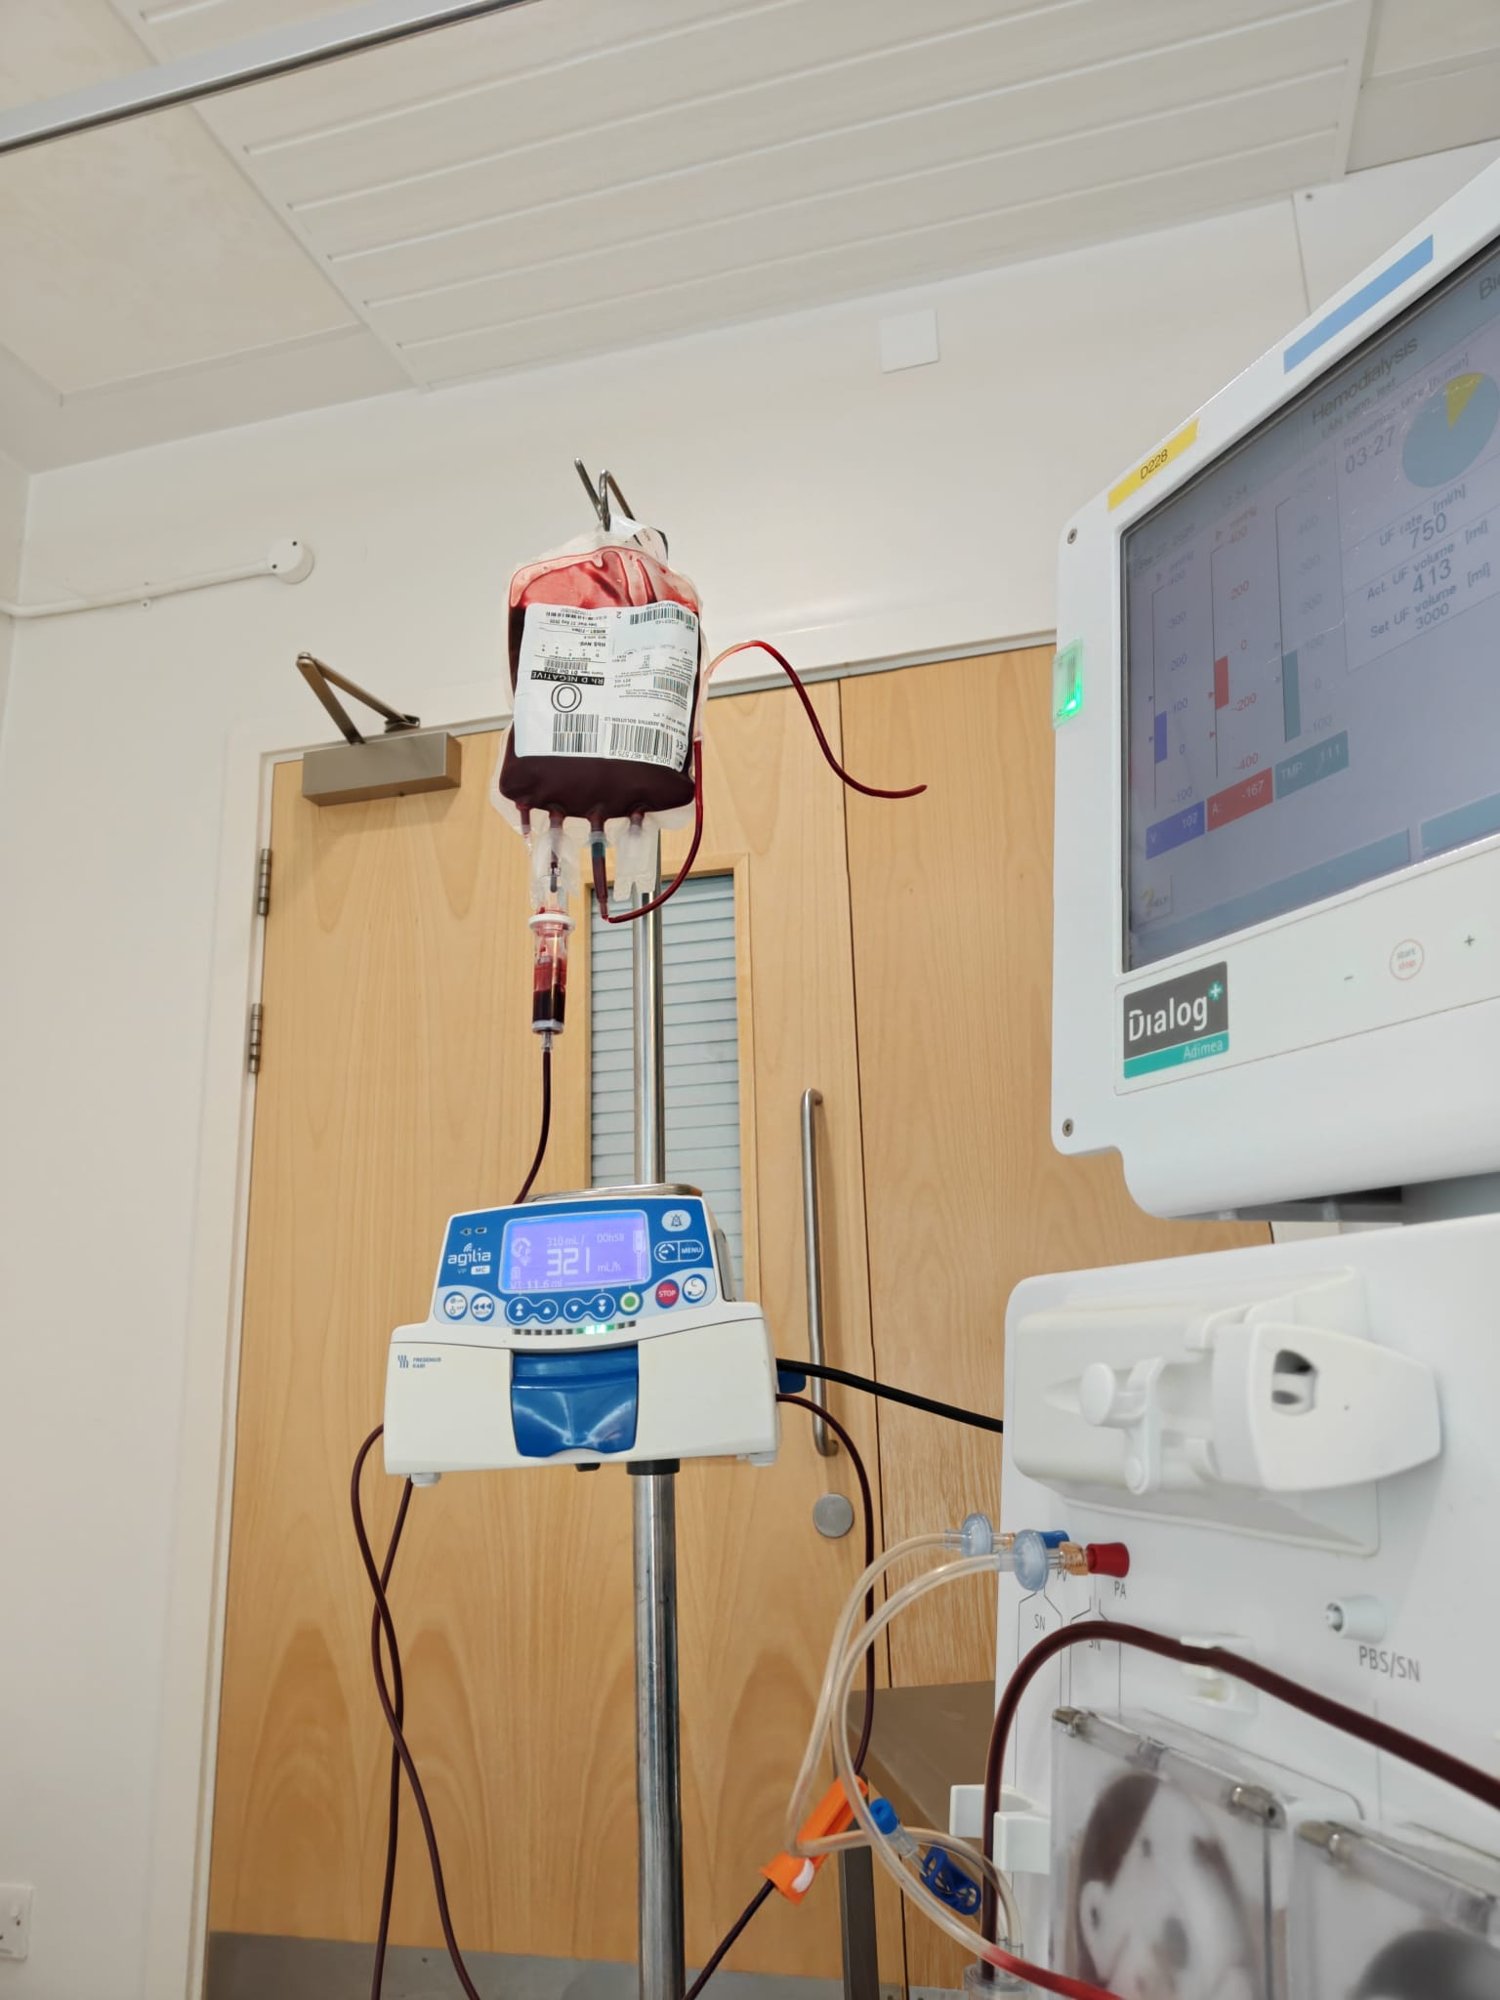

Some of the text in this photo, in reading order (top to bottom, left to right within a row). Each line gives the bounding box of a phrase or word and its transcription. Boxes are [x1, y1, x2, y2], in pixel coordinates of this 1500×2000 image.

[1312, 337, 1419, 425] Hemodialysis
[1345, 425, 1396, 475] 03:27
[1140, 449, 1168, 481] D228
[1379, 529, 1395, 547] UF
[1409, 511, 1447, 549] 750
[1392, 566, 1409, 585] UF
[1413, 543, 1456, 572] volume
[1412, 557, 1452, 593] 413
[1370, 620, 1390, 639] Set
[1393, 608, 1410, 626] UF
[1413, 584, 1458, 614] volume
[1415, 602, 1450, 630] 3000
[531, 672, 578, 683] NEGATIVE
[1241, 779, 1265, 798] -167
[1183, 1038, 1224, 1061] Adimea
[447, 1247, 492, 1266] agilia
[546, 1247, 591, 1277] 321
[681, 1246, 702, 1254] MENU
[658, 1289, 677, 1298] STOP
[1114, 1580, 1127, 1600] PA
[1034, 1614, 1046, 1632] SN
[1358, 1645, 1421, 1683] PBS/SN
